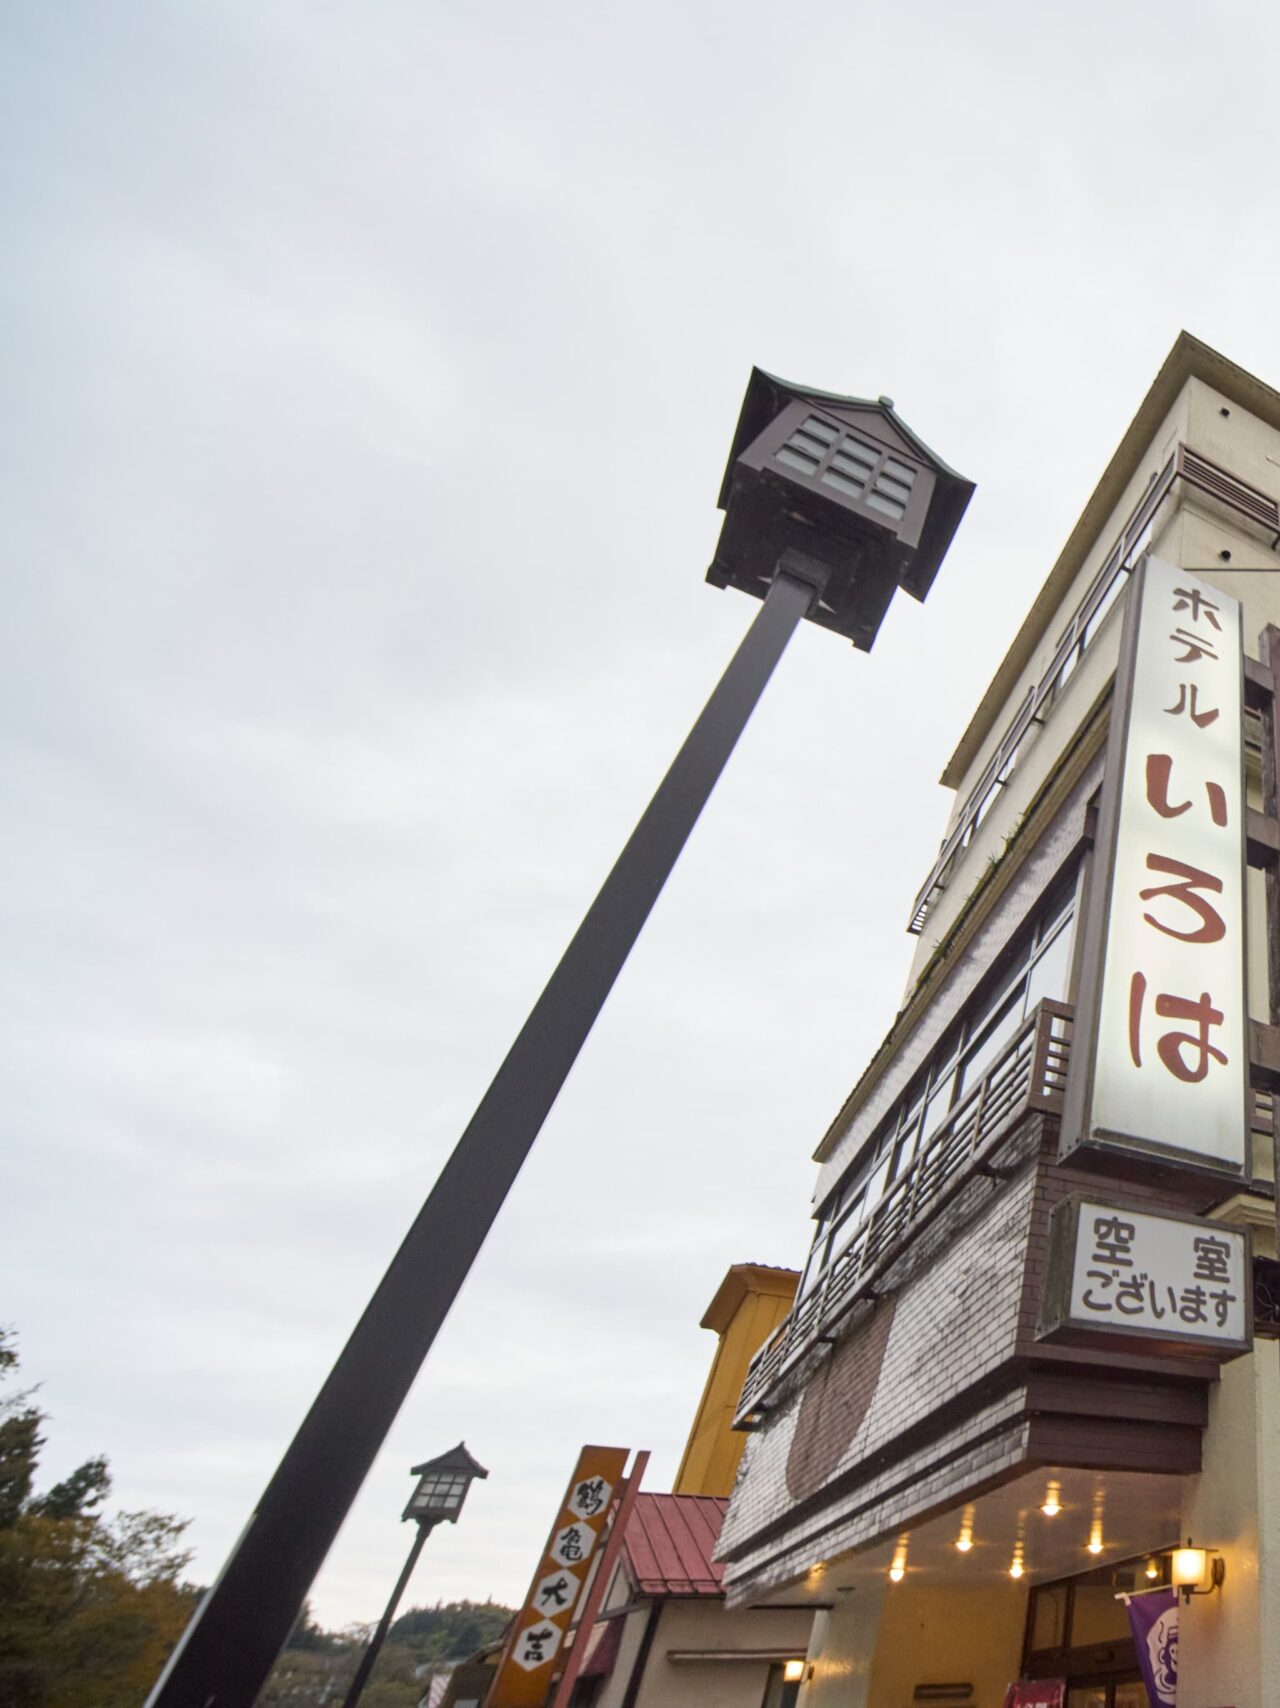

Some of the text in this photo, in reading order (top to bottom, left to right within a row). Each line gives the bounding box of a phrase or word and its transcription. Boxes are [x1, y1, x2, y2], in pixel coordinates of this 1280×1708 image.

[1082, 1268, 1236, 1328] ございます
